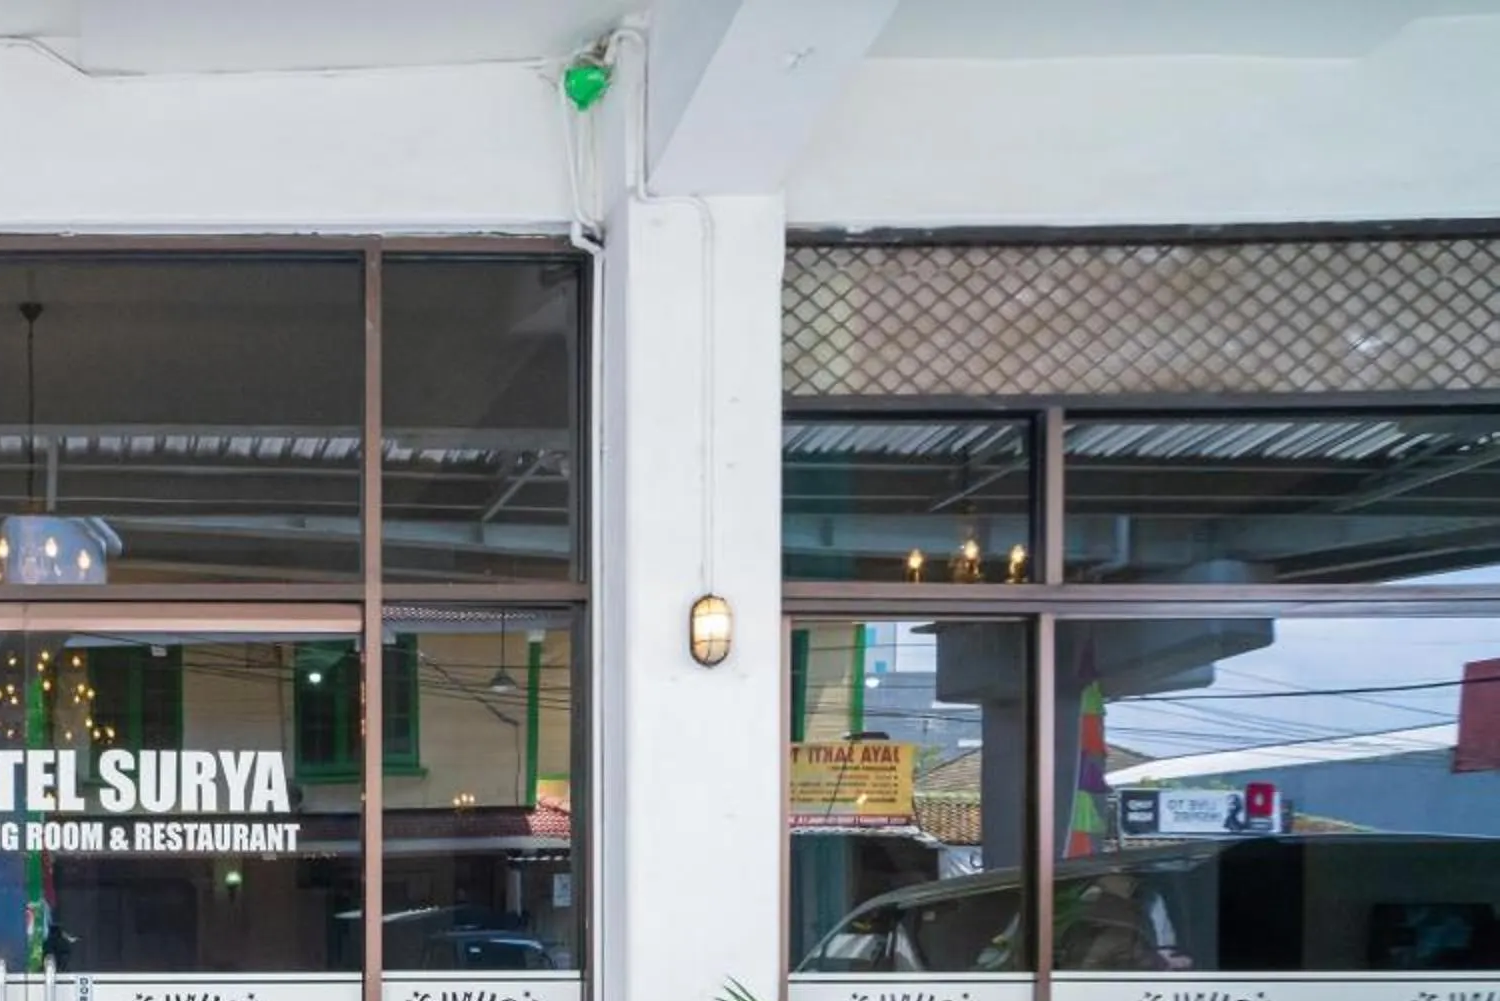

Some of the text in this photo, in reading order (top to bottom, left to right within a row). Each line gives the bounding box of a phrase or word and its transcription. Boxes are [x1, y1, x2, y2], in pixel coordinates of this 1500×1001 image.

[99, 749, 292, 812] SURYA
[26, 822, 104, 851] ROOM
[110, 826, 129, 851] &
[134, 822, 301, 852] RESTAURANT
